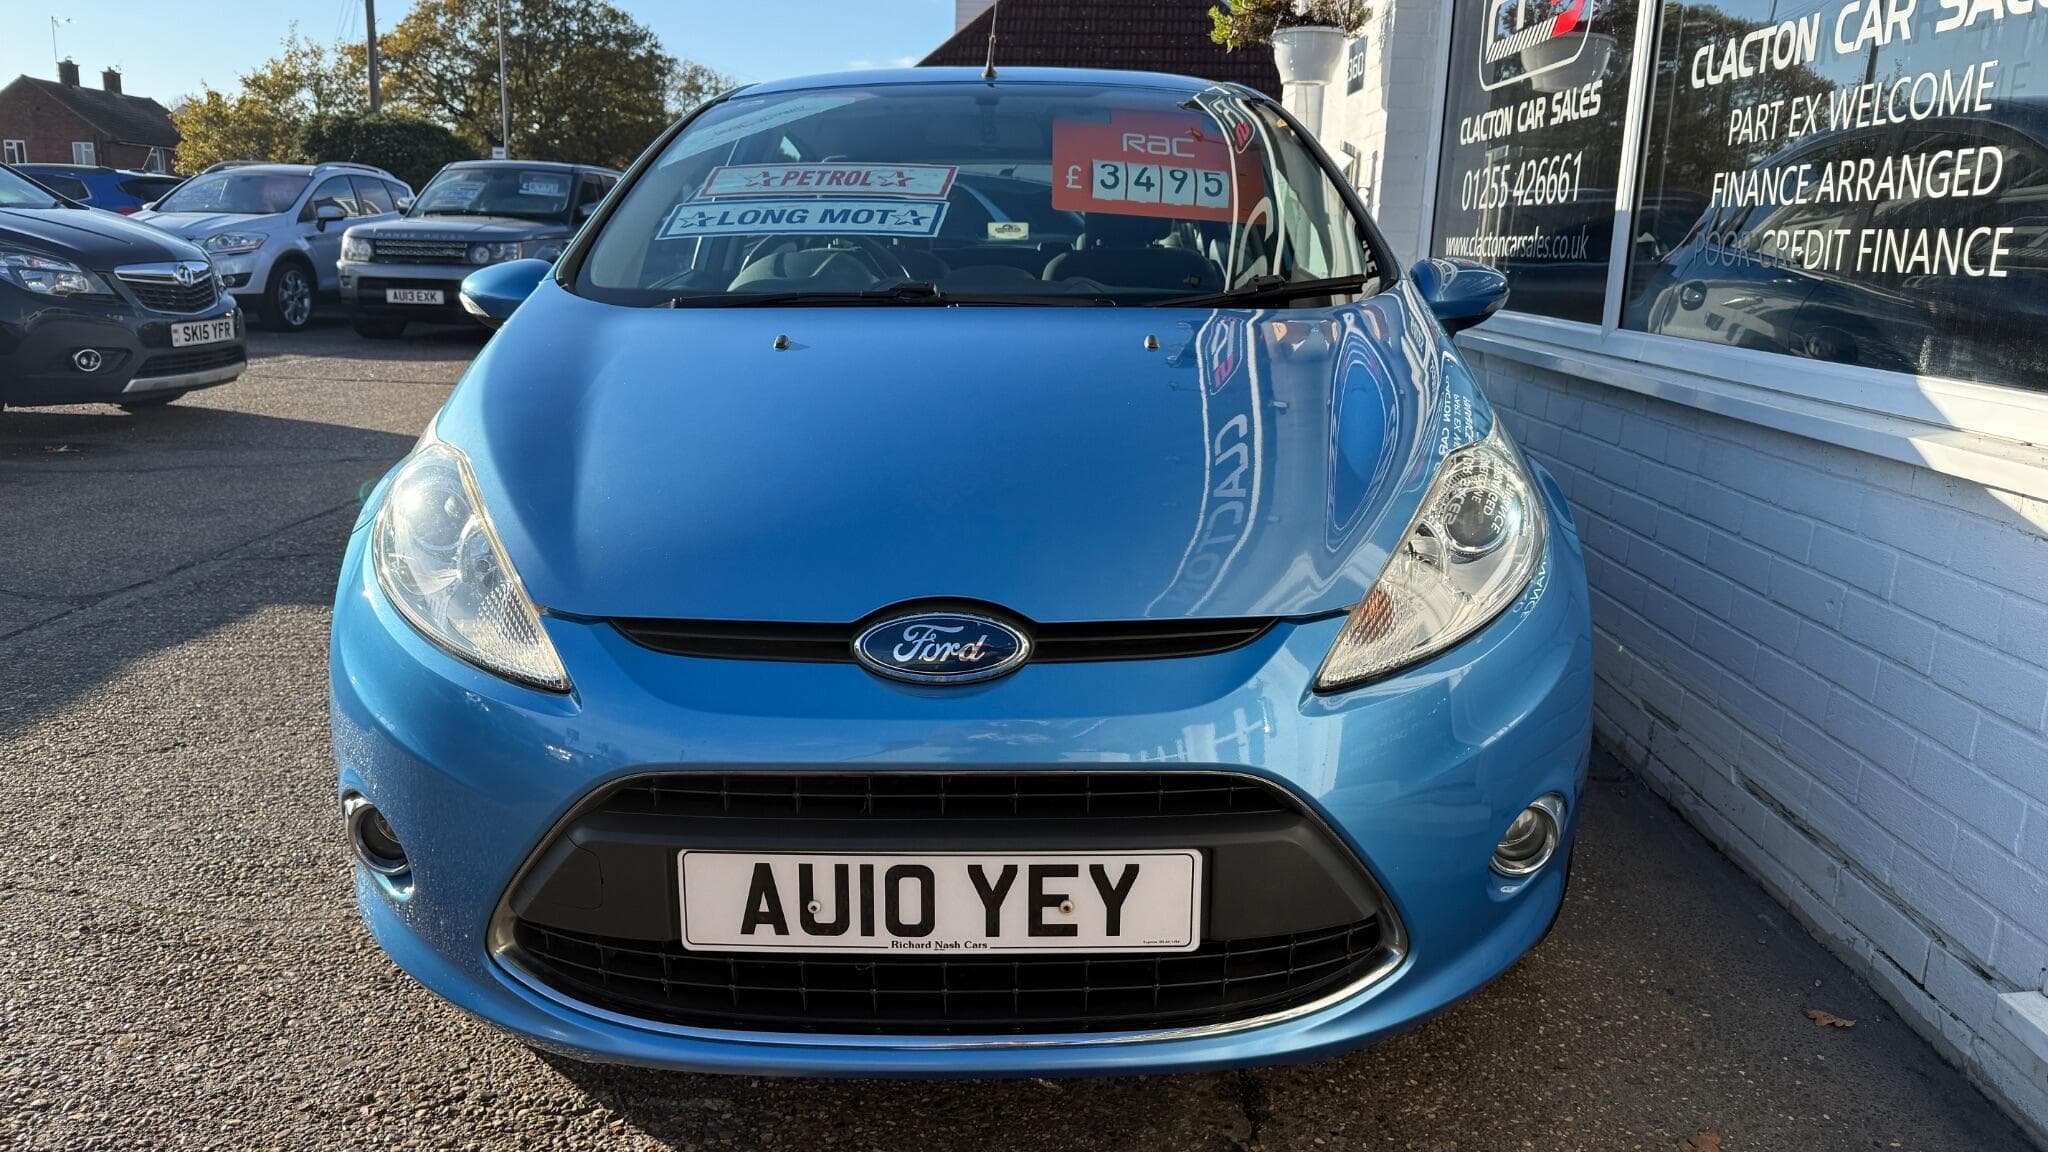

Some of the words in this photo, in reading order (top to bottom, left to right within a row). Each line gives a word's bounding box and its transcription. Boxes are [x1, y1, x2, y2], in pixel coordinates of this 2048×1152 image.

[1691, 12, 1821, 89] CLACTON
[1834, 0, 1917, 55] CAR
[1346, 51, 1364, 82] 360
[1460, 105, 1514, 146] CLACTON
[1517, 97, 1546, 133] CAR
[1550, 80, 1603, 126] SALES
[1728, 101, 1785, 146] PART
[1789, 93, 1823, 138] EX
[1829, 60, 1999, 132] WELCOME
[780, 170, 872, 187] PETROL
[1461, 164, 1511, 211] 01255
[1512, 151, 1583, 206] 426661
[1711, 164, 1811, 208] FINANCE
[1814, 146, 2004, 205] ARRANGED
[716, 209, 809, 225] LONG
[818, 209, 896, 225] MOT
[1446, 225, 1590, 260] www.clactoncarsales.co.uk
[1693, 231, 1751, 267] POOR
[1760, 229, 1851, 270] CREDIT
[1856, 227, 2014, 277] FINANCE
[393, 290, 416, 302] AU13
[417, 290, 437, 302] EXK
[183, 325, 209, 342] SK15
[211, 321, 231, 339] YFR
[893, 624, 988, 662] Ford
[740, 863, 936, 937] AU10
[967, 864, 1140, 937] YEY
[891, 940, 931, 949] Richard
[934, 940, 961, 950] Nash
[964, 940, 988, 949] Cars
